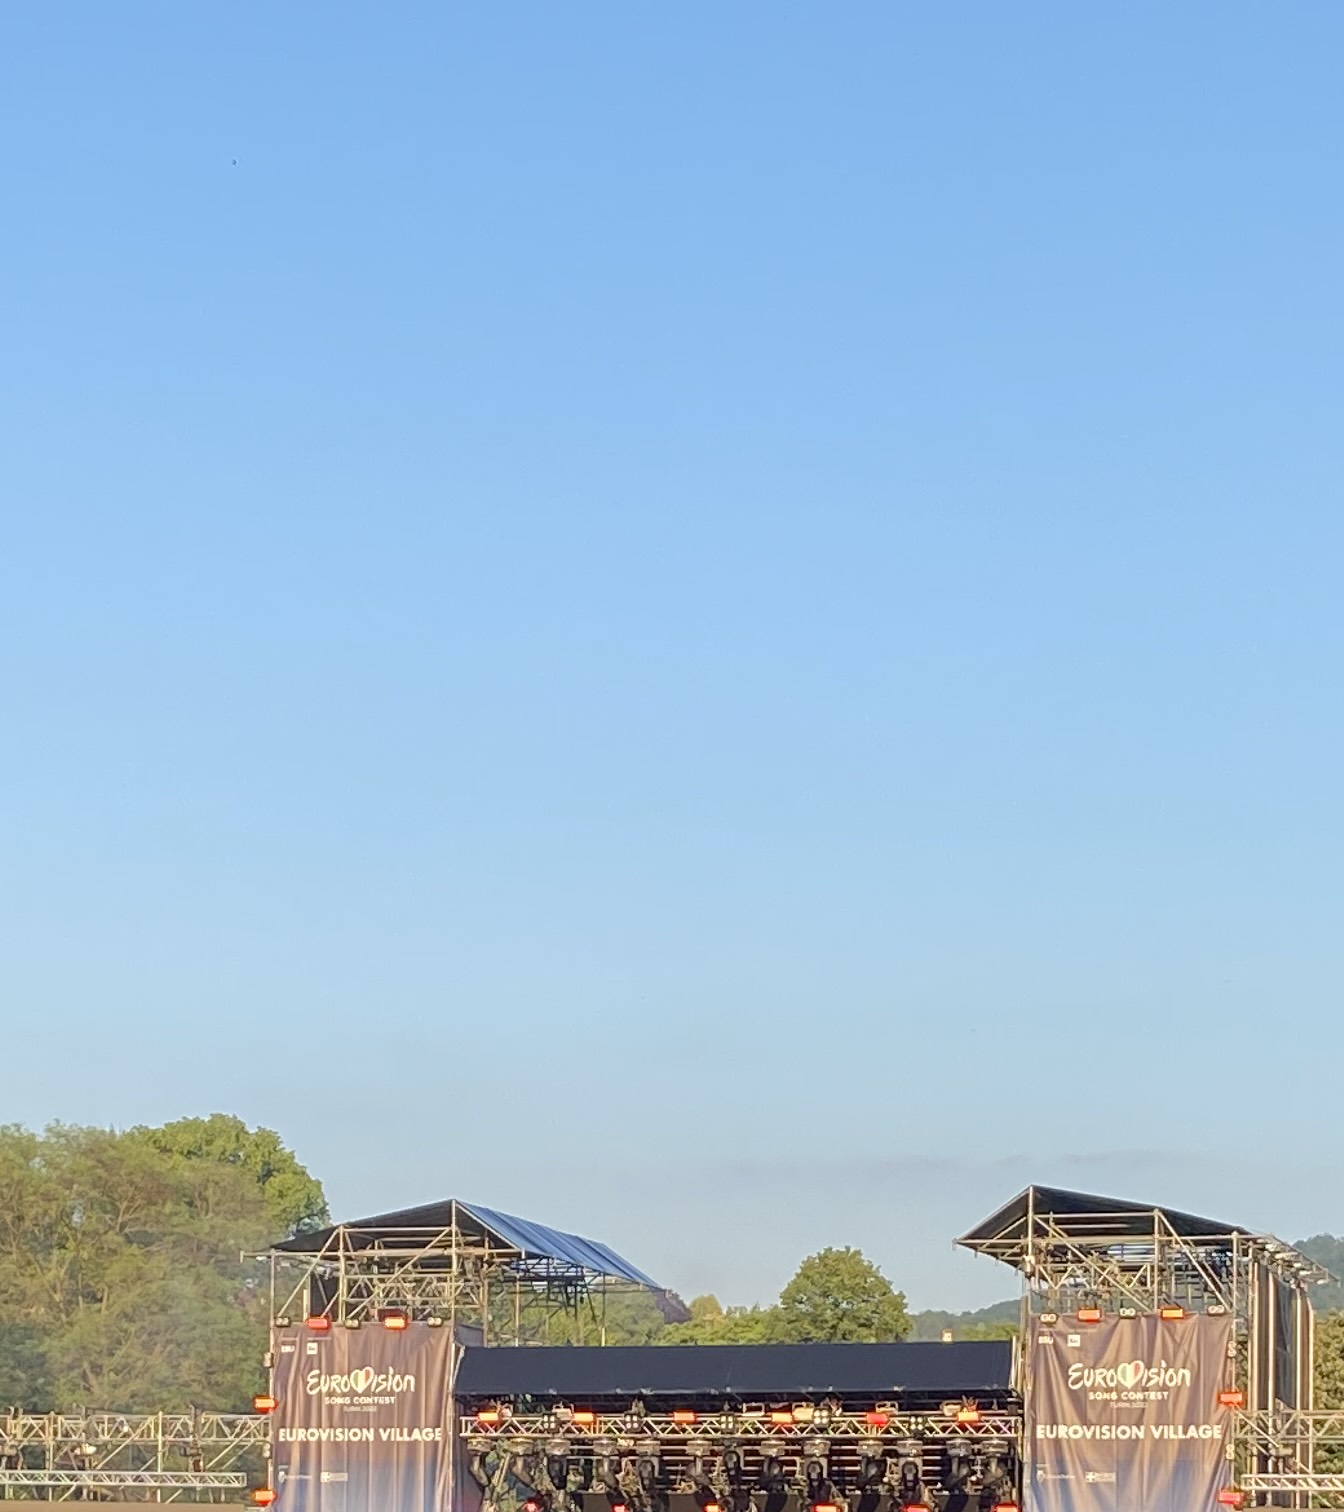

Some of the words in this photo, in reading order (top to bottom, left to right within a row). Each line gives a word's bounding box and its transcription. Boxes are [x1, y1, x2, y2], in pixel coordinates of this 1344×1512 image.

[353, 1396, 397, 1404] CONTEST
[1121, 1391, 1169, 1400] CONTEST
[278, 1427, 374, 1441] EUROVISION
[379, 1427, 442, 1441] VILLAGE
[1036, 1425, 1145, 1439] EUROVISION
[1149, 1425, 1222, 1439] VILLAGE
